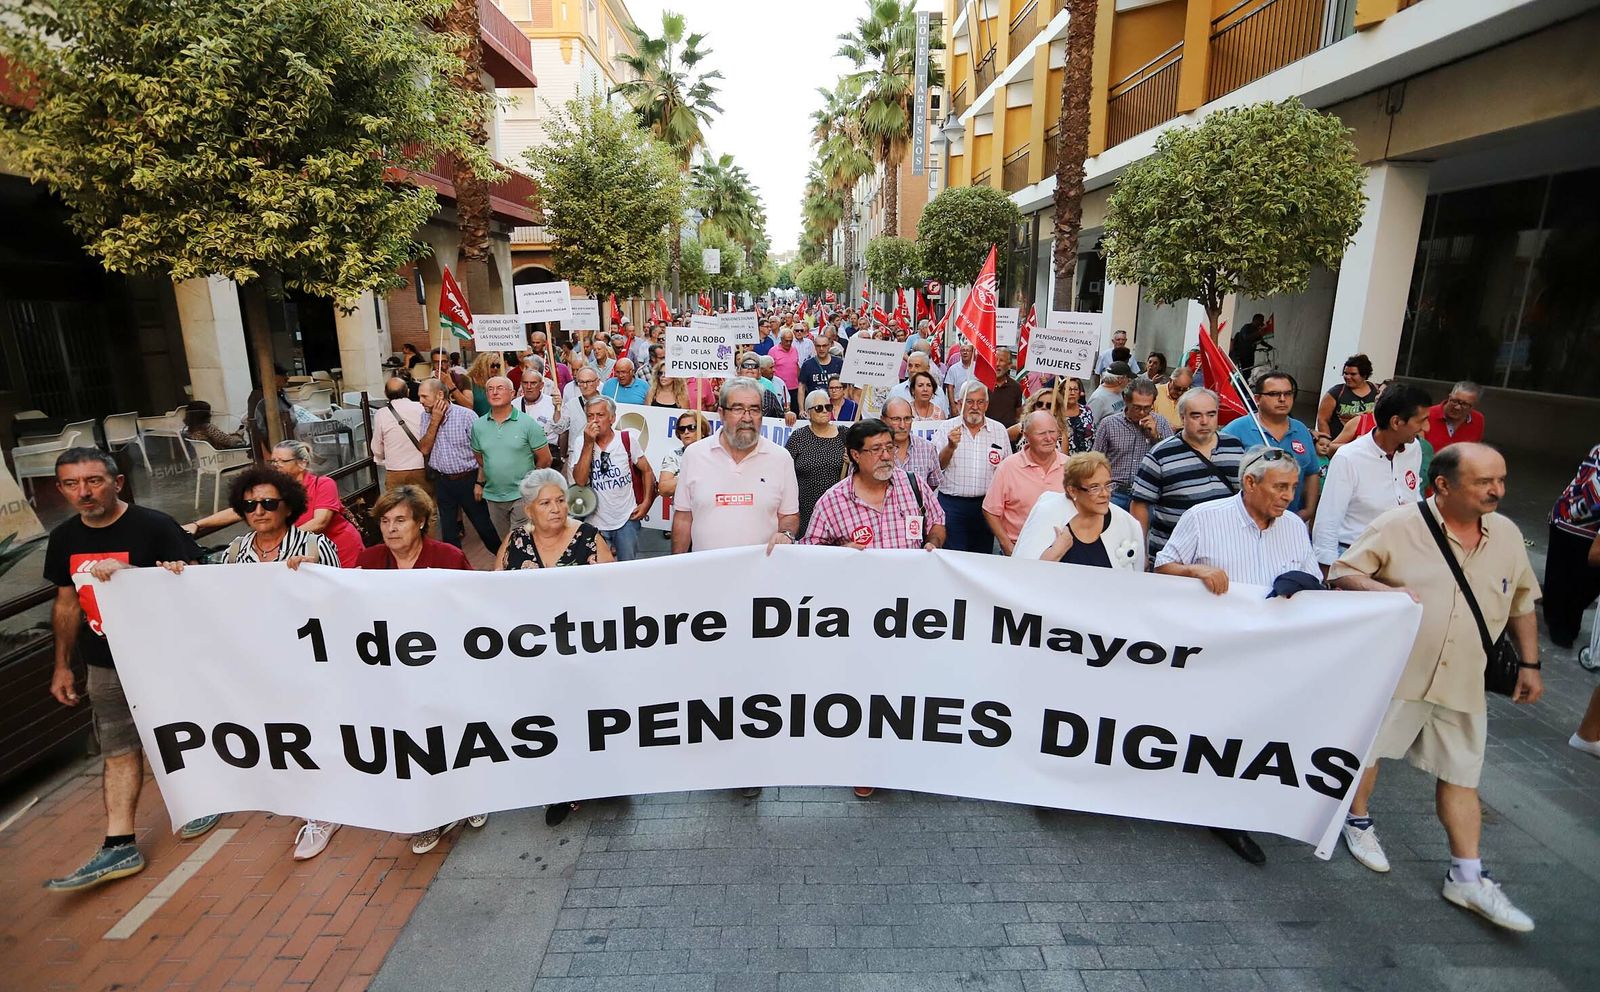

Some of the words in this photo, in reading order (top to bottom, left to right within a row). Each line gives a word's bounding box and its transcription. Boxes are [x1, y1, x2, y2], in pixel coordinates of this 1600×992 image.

[918, 16, 927, 66] HOTEL
[915, 74, 925, 167] TARTESSOS
[676, 335, 689, 343] NO
[690, 336, 701, 344] AL
[702, 336, 726, 344] ROBO
[1035, 333, 1068, 343] PENSIONES
[1068, 337, 1092, 346] DIGNAS
[671, 360, 729, 371] PENSIONES
[1035, 357, 1082, 371] MUJERES
[591, 467, 621, 481] OPAGO
[297, 617, 328, 663] 1
[356, 620, 437, 667] de
[464, 605, 727, 660] octubre
[753, 595, 850, 639] Día
[874, 597, 967, 641] del
[992, 606, 1203, 669] Mayor
[153, 721, 320, 775] POR
[340, 715, 559, 780] UNAS
[588, 693, 1012, 752] PENSIONES
[1041, 708, 1360, 801] DIGNAS
